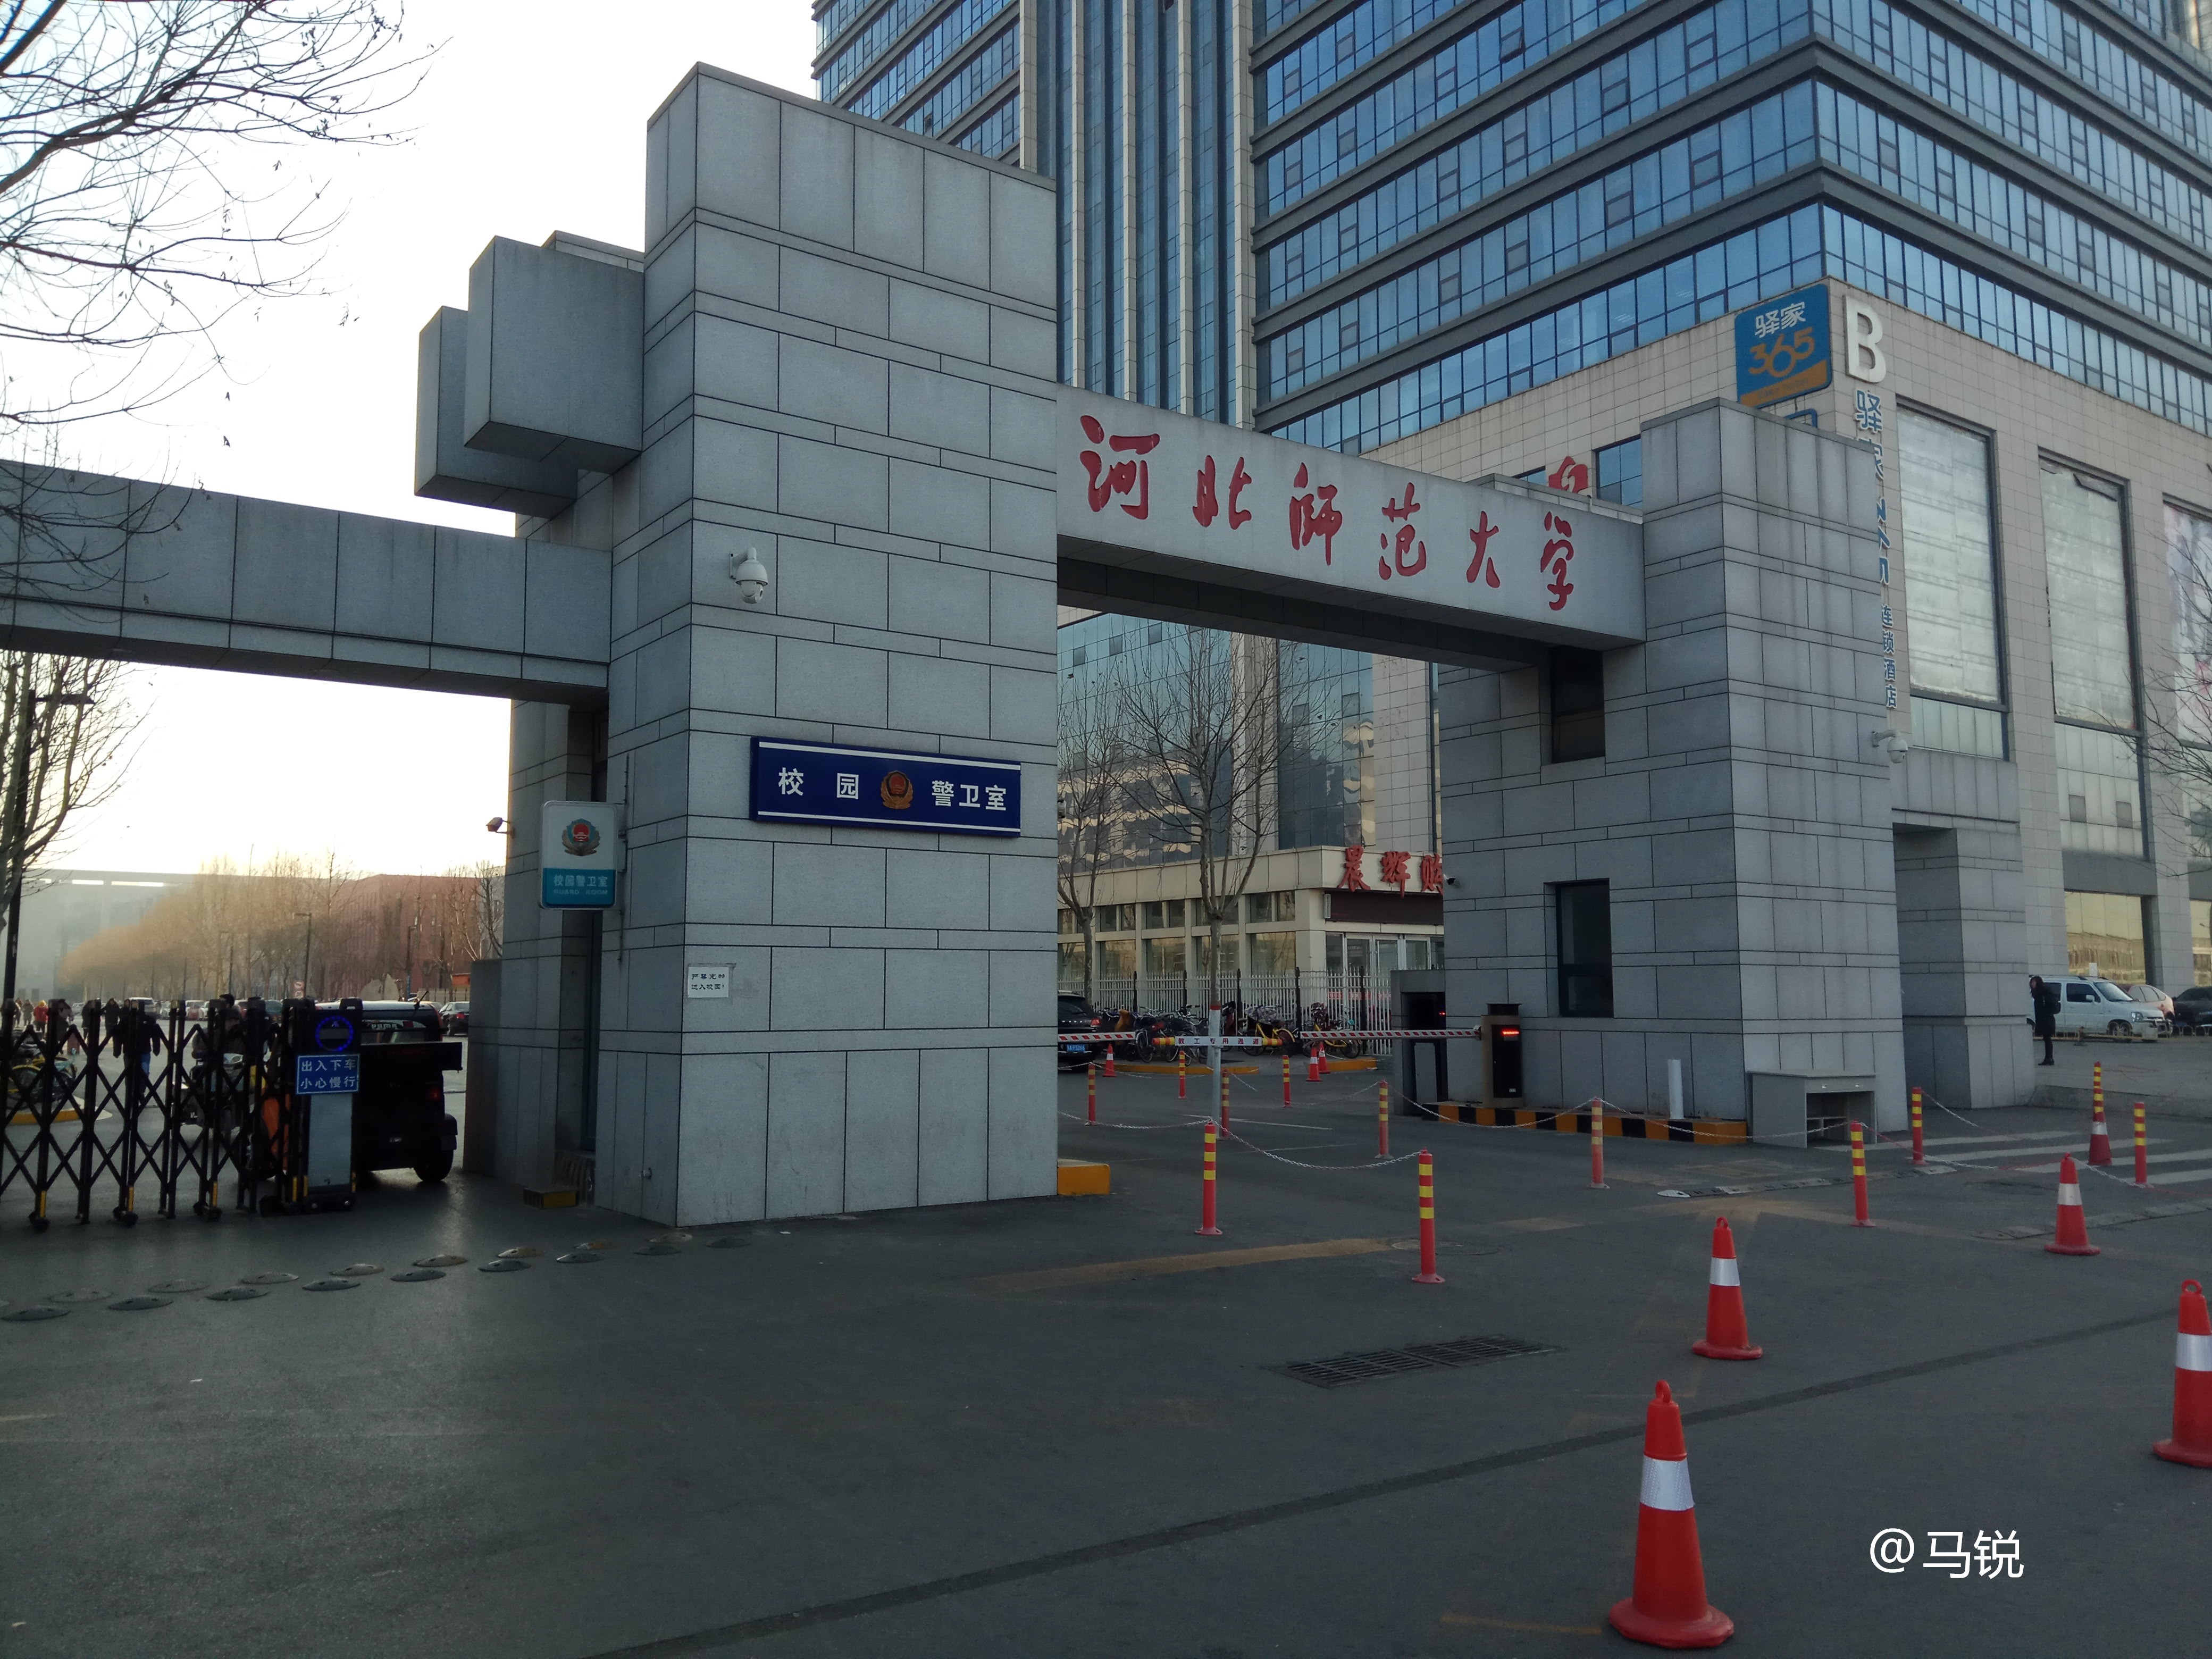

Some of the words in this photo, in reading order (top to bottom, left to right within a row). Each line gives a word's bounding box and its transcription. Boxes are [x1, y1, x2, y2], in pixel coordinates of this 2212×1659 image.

[1755, 301, 1806, 338] 驿家
[1843, 295, 1887, 383] B
[1748, 326, 1815, 378] 365
[1080, 415, 1574, 610] 河北师范大学
[778, 767, 859, 800] 校园
[932, 780, 1007, 811] 警卫室
[300, 1076, 356, 1089] 小心慢行
[301, 1059, 356, 1071] 出入下车
